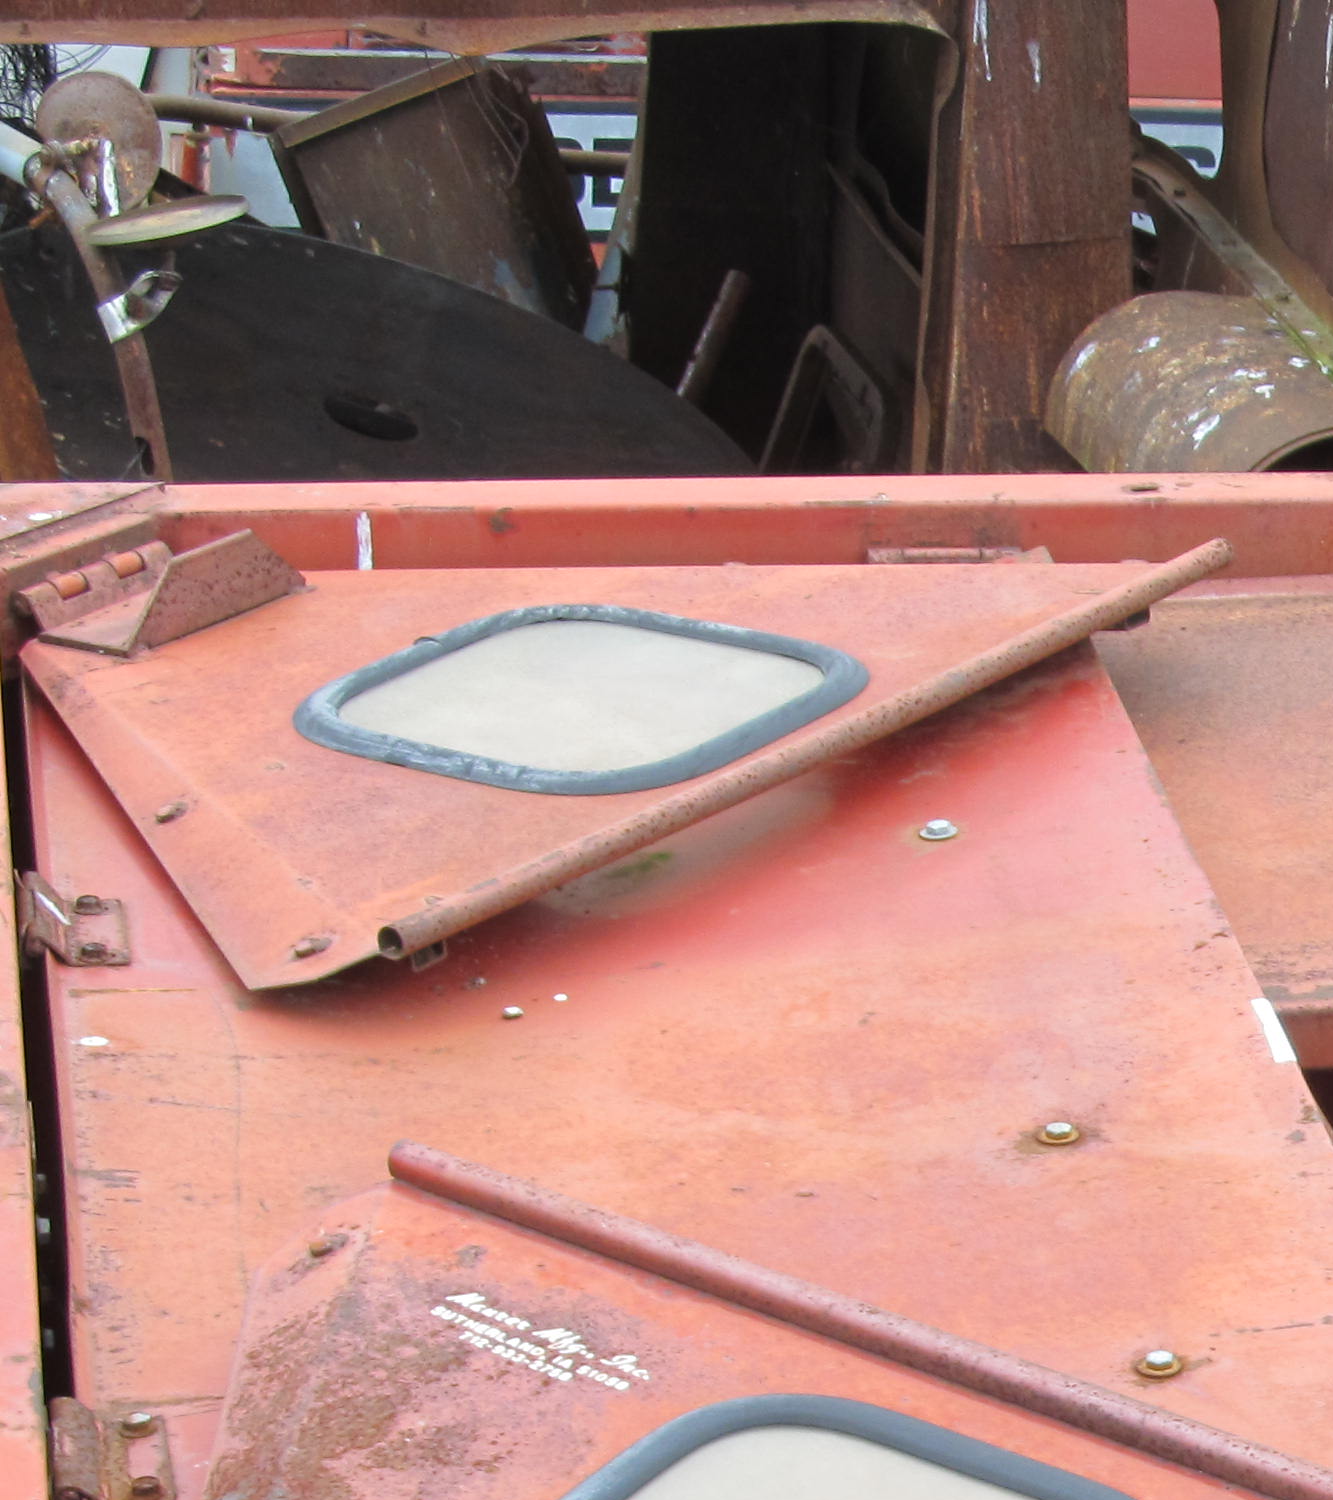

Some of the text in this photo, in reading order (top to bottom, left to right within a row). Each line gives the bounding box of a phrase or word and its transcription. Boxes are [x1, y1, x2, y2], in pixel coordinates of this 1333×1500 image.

[445, 1293, 531, 1331] Maurer
[599, 1354, 650, 1381] Inc.
[551, 1356, 574, 1369] IA
[575, 1365, 631, 1391] 51058
